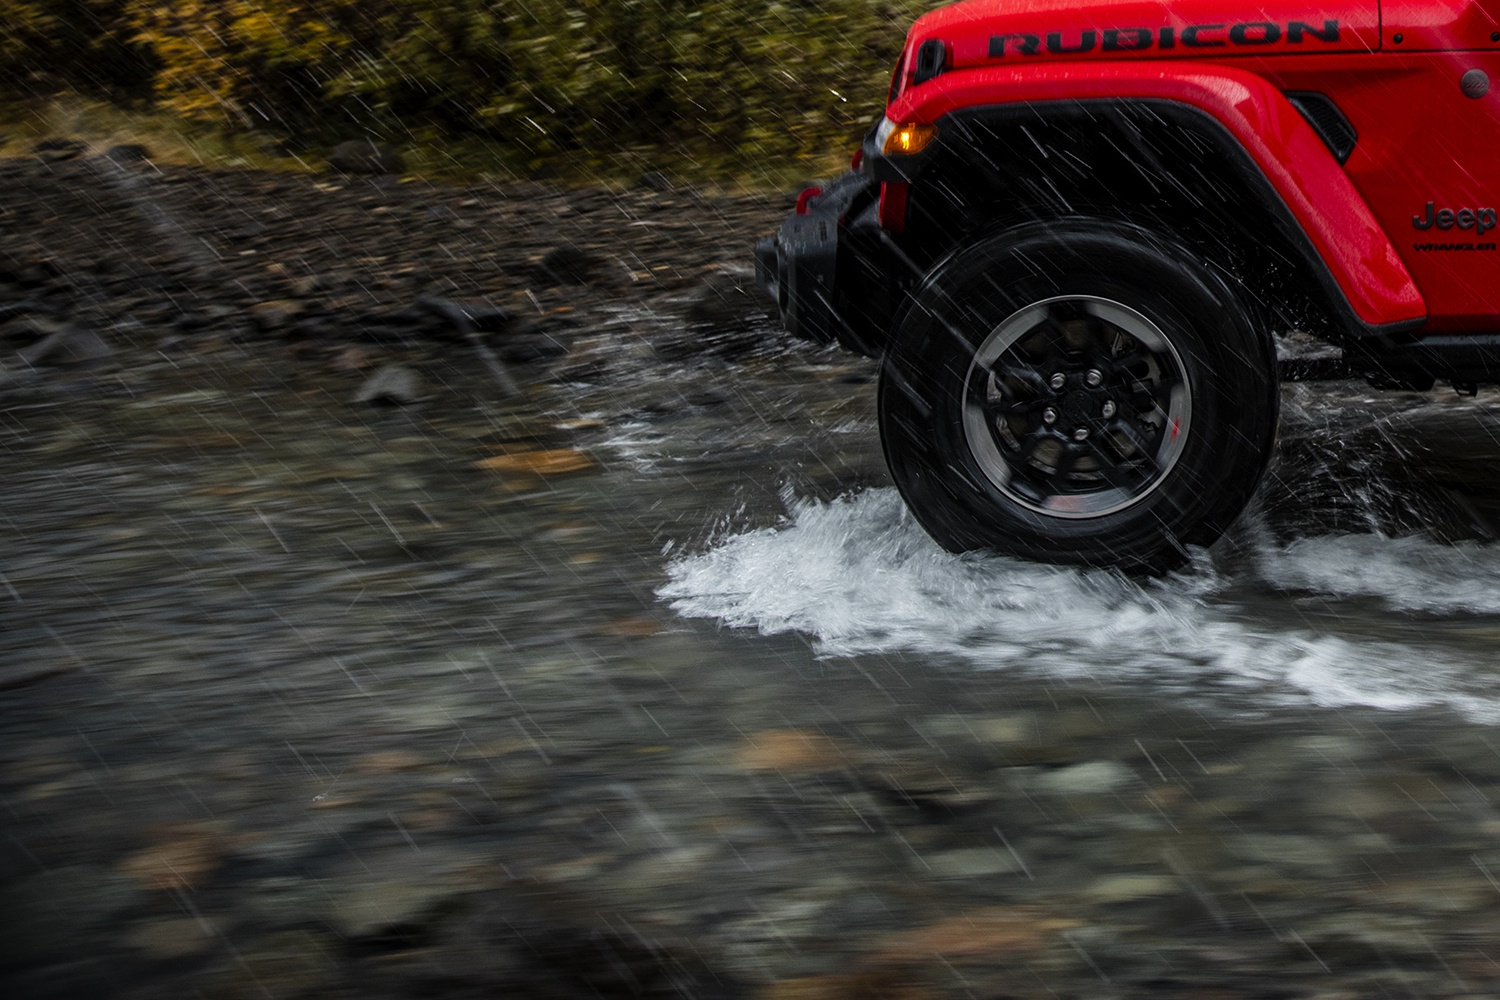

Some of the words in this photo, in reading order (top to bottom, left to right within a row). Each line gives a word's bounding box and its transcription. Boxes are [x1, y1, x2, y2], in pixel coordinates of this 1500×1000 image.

[988, 20, 1339, 57] RUBICON
[1413, 201, 1497, 234] Jeep
[1413, 243, 1496, 252] WRANGLER
